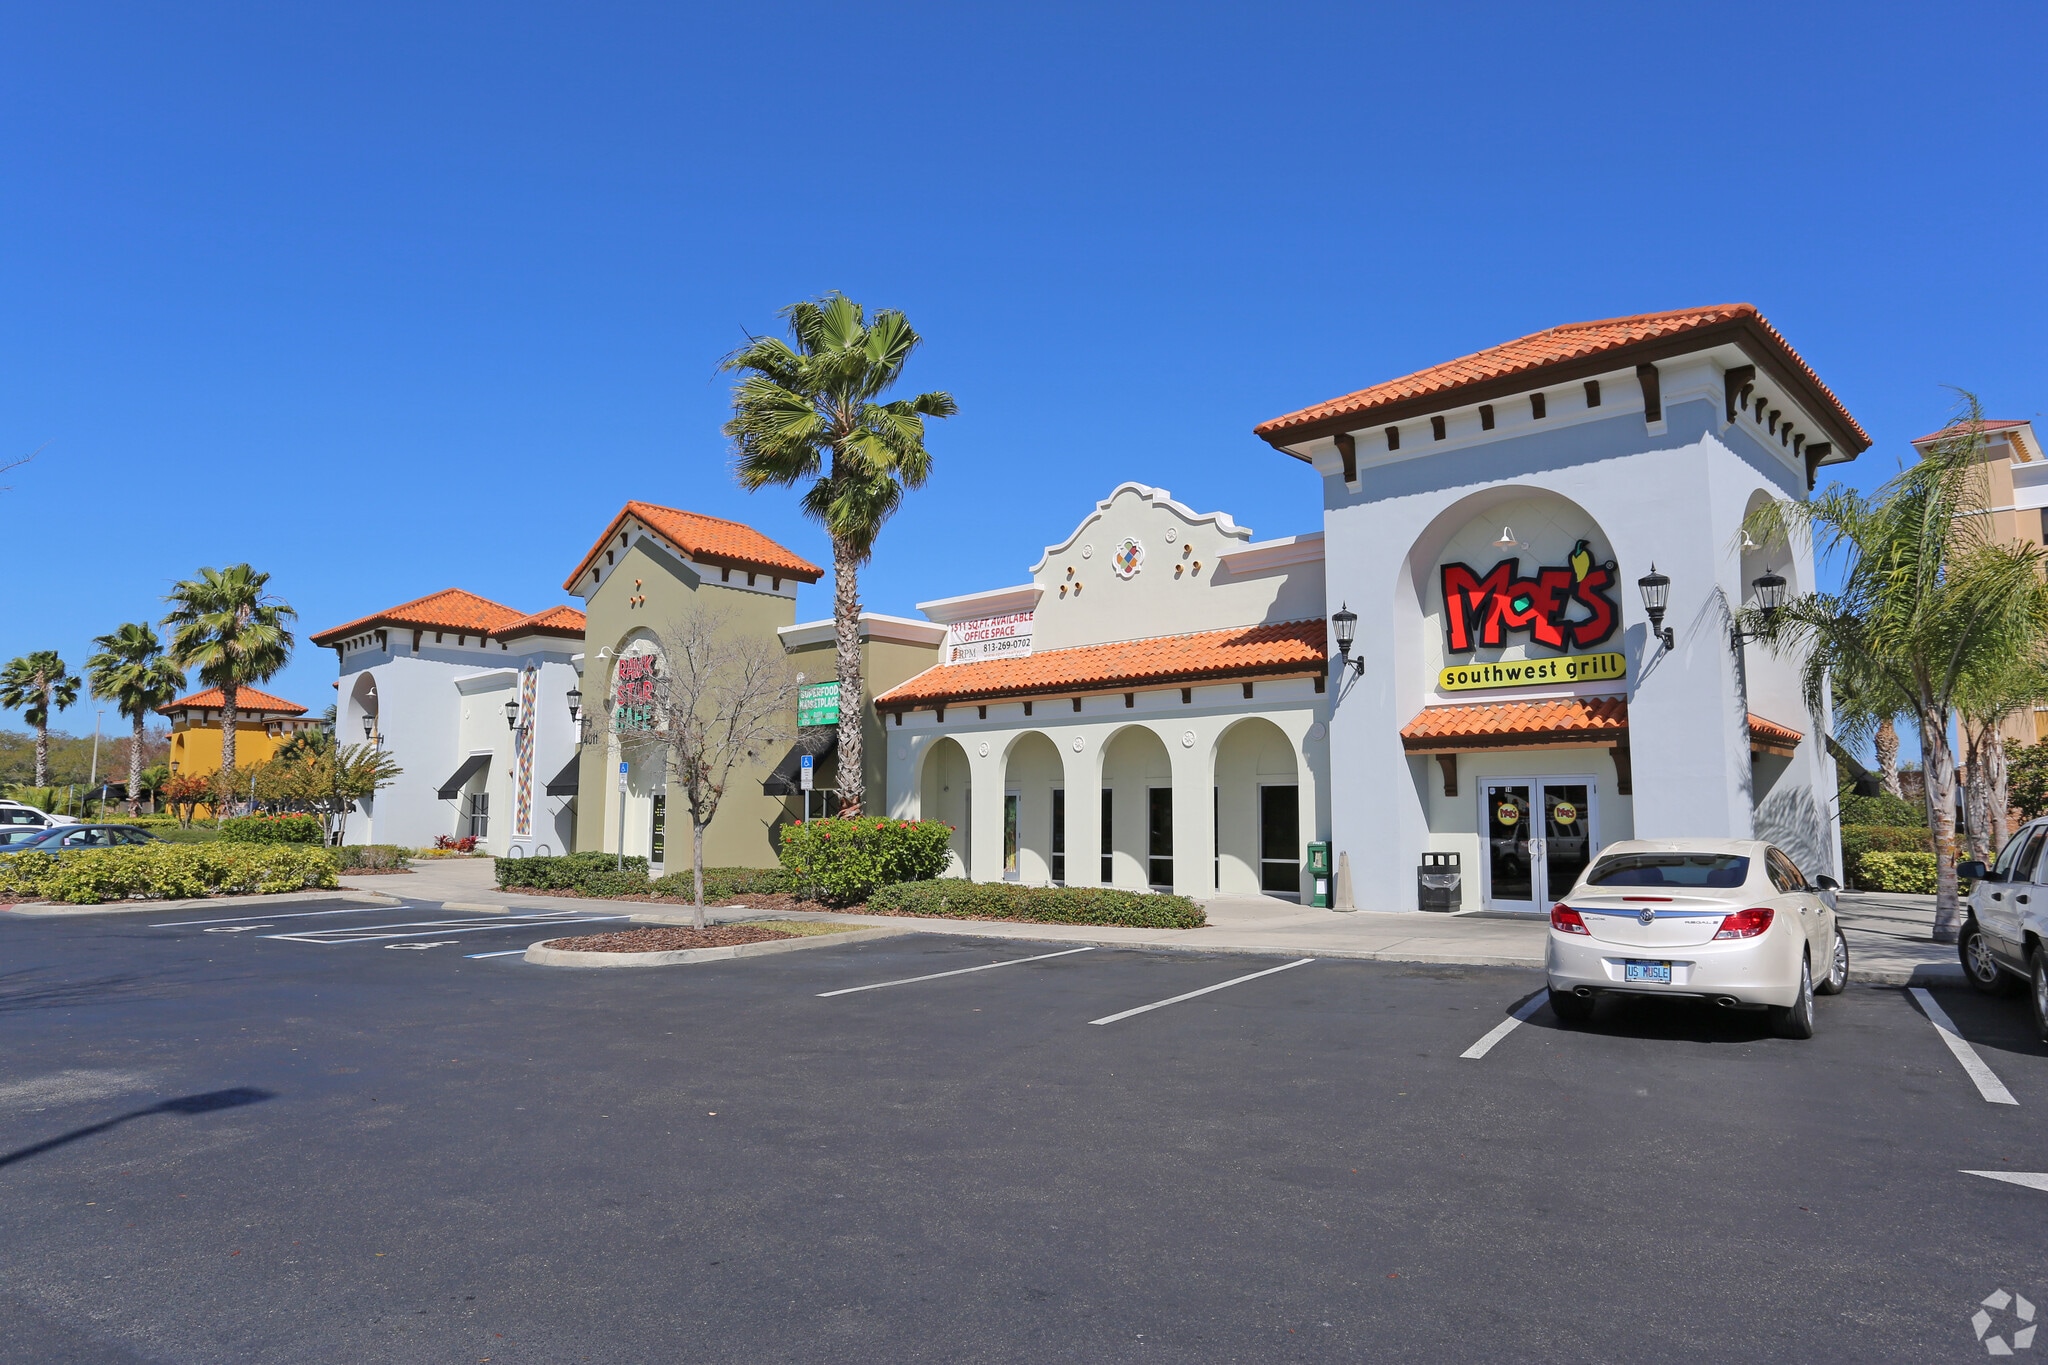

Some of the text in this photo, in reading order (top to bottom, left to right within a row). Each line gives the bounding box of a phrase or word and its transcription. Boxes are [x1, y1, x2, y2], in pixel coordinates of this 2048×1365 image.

[991, 611, 1034, 627] AVAILABLE
[964, 625, 1015, 642] OFFICE SPACE
[959, 648, 977, 659] RPM
[983, 638, 1031, 653] 813-269-0702
[1446, 654, 1617, 685] southwest grill
[617, 680, 653, 705] STAR
[800, 684, 839, 699] SUPERFOOD
[615, 705, 652, 733] CAFE
[1628, 966, 1668, 979] US MUSLE
